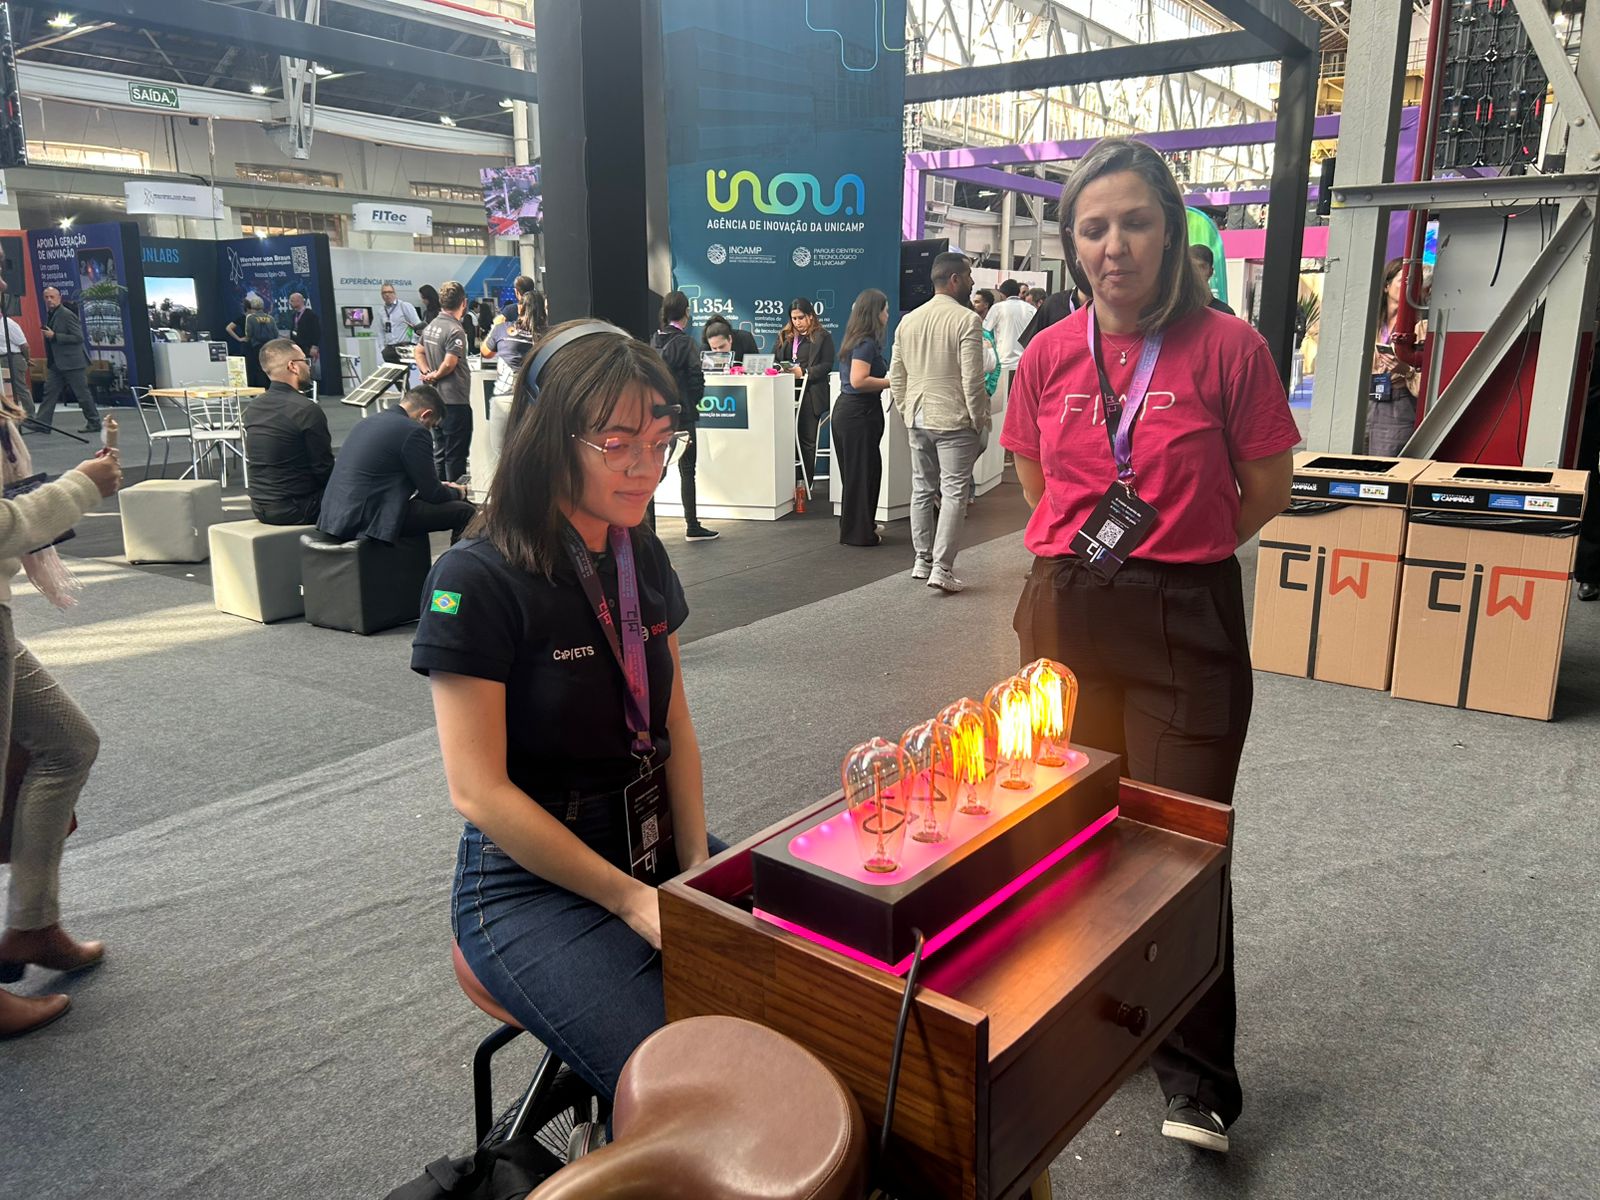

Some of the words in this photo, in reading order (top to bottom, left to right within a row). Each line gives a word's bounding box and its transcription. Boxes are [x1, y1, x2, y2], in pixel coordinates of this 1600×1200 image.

[133, 88, 170, 104] SAÍDA
[372, 210, 407, 222] FITec
[707, 217, 747, 230] AGÊNCIA
[749, 219, 761, 230] DE
[763, 219, 808, 234] INOVAÇÃO
[810, 221, 822, 232] DA
[824, 221, 865, 232] UNICAMP
[36, 237, 53, 249] APOIO
[54, 235, 60, 248] À
[60, 233, 87, 248] GERAÇÃO
[38, 250, 46, 260] DE
[46, 247, 75, 261] INOVAÇÃO
[728, 246, 762, 254] INCAMP
[692, 298, 734, 314] 1.354
[755, 300, 784, 315] 233
